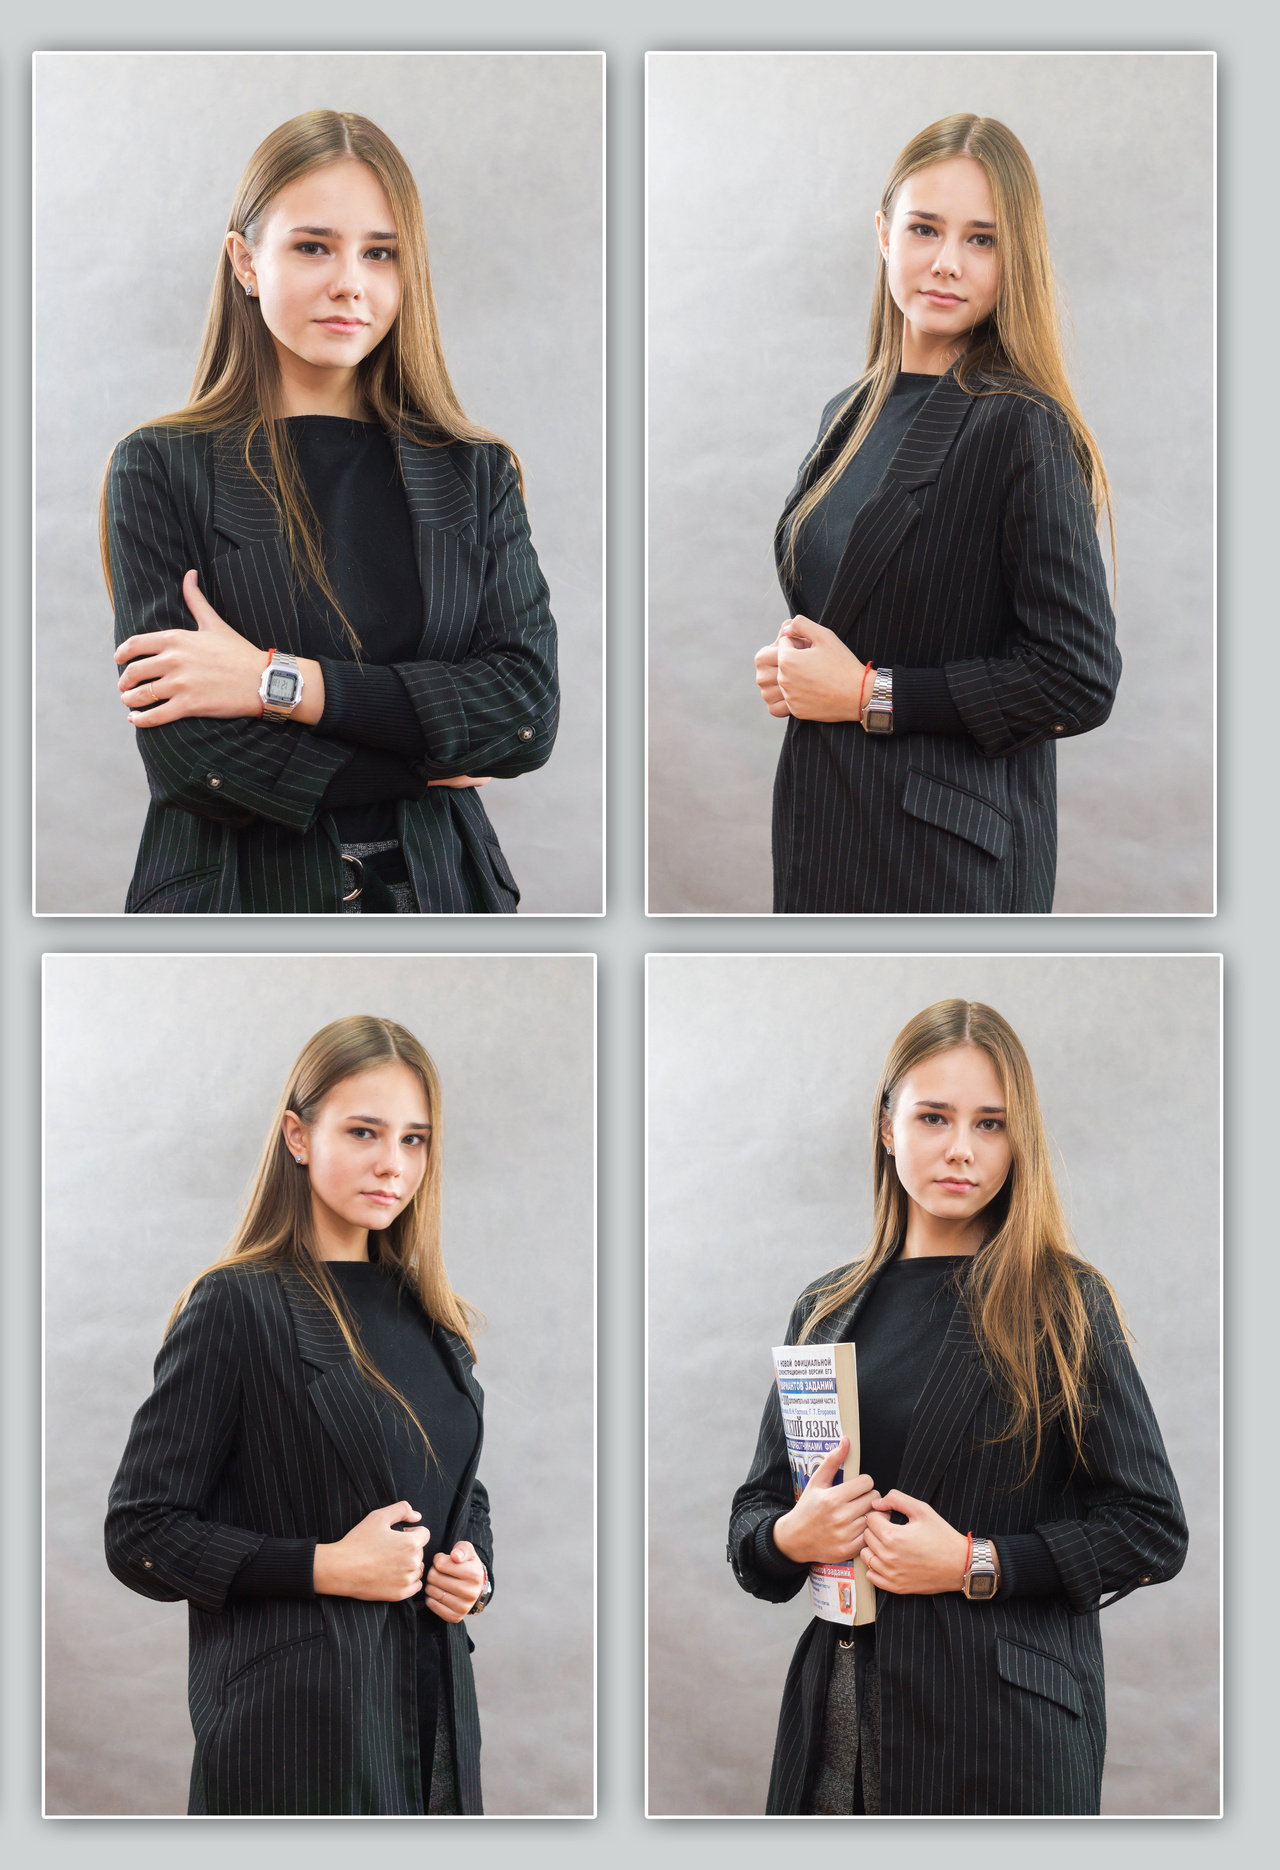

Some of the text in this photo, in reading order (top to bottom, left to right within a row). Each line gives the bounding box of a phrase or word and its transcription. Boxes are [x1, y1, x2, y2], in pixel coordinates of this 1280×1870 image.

[794, 1357, 832, 1368] ОФИЦИАЛЬНОЙ
[805, 1379, 834, 1393] ЗАДАНИЙ
[805, 1420, 840, 1438] ЯЗЫК
